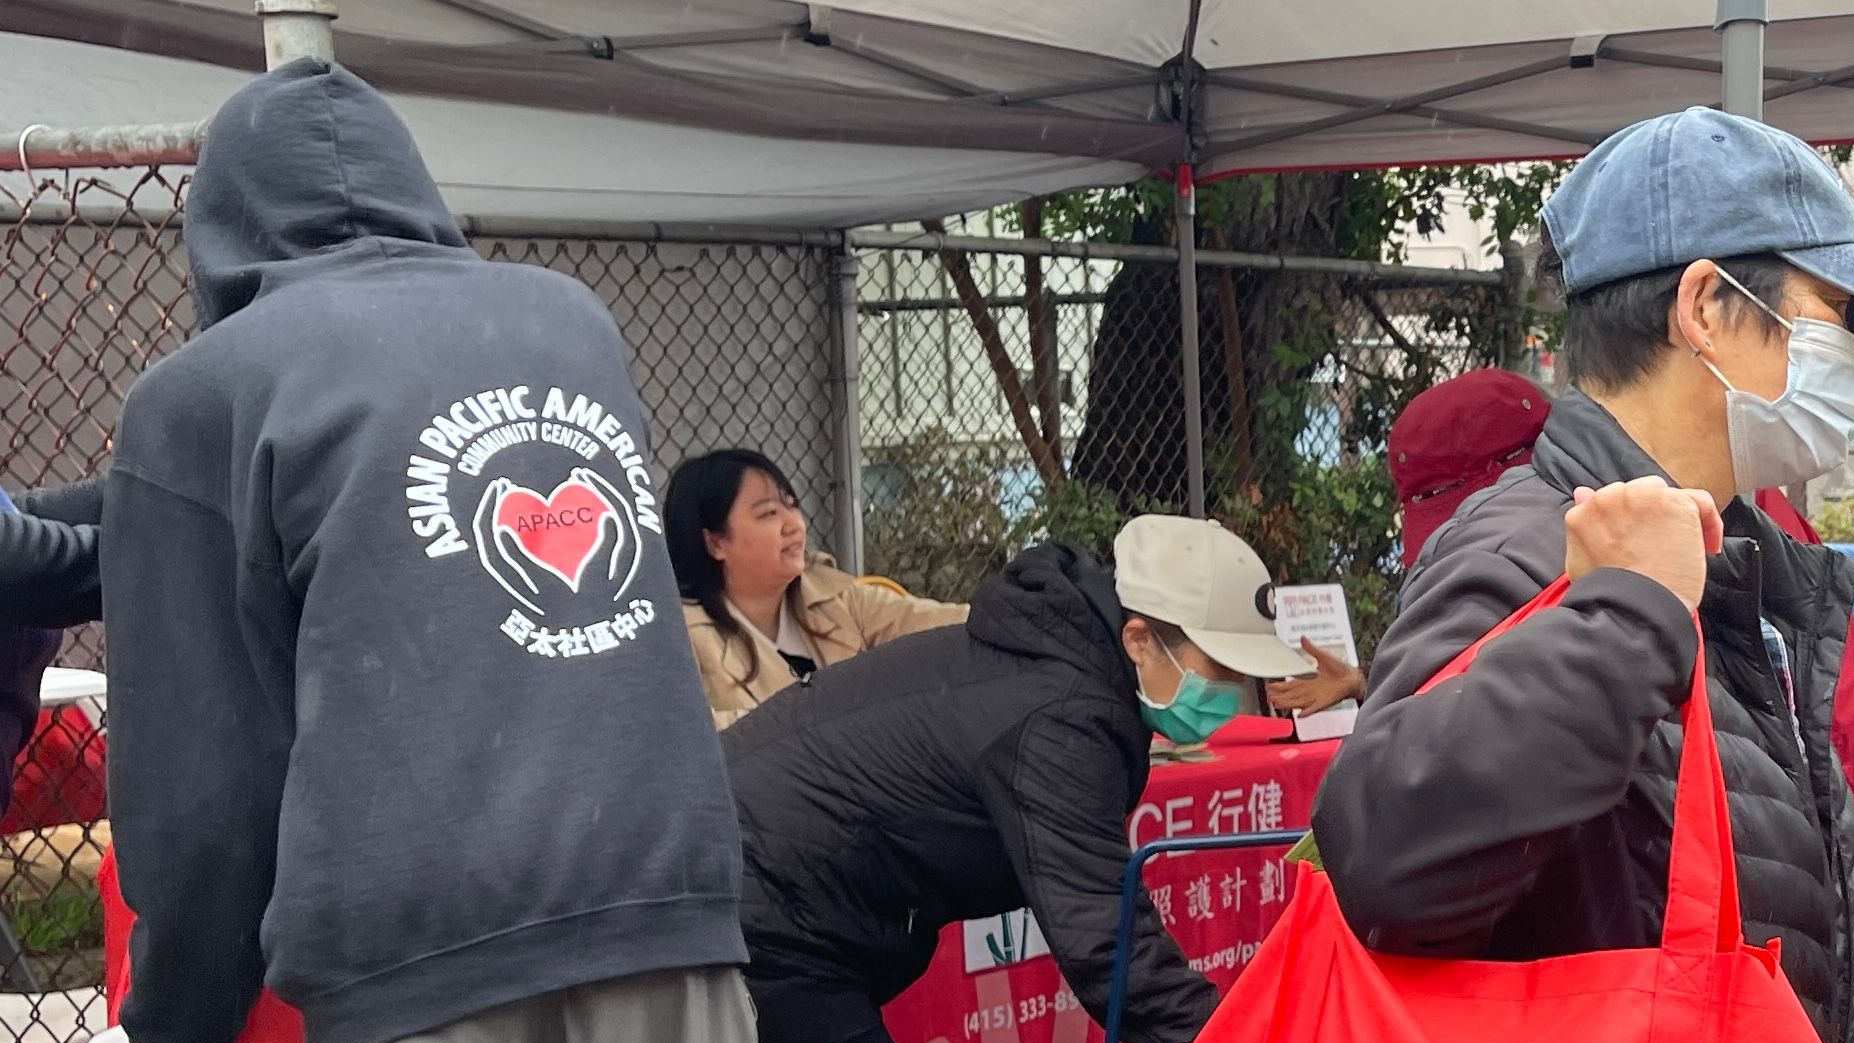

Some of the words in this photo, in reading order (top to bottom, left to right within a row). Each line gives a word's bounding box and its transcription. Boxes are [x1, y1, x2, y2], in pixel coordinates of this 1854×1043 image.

[419, 386, 537, 459] PACIFIC
[457, 421, 537, 476] COMMUNITY
[541, 421, 600, 461] CENTER
[541, 386, 661, 535] AMERICAN
[406, 455, 469, 558] ASIAN
[517, 507, 593, 532] APACC
[500, 599, 655, 658] 亞太社區中心
[1208, 779, 1284, 834] 行健
[964, 1003, 1014, 1040] (415)
